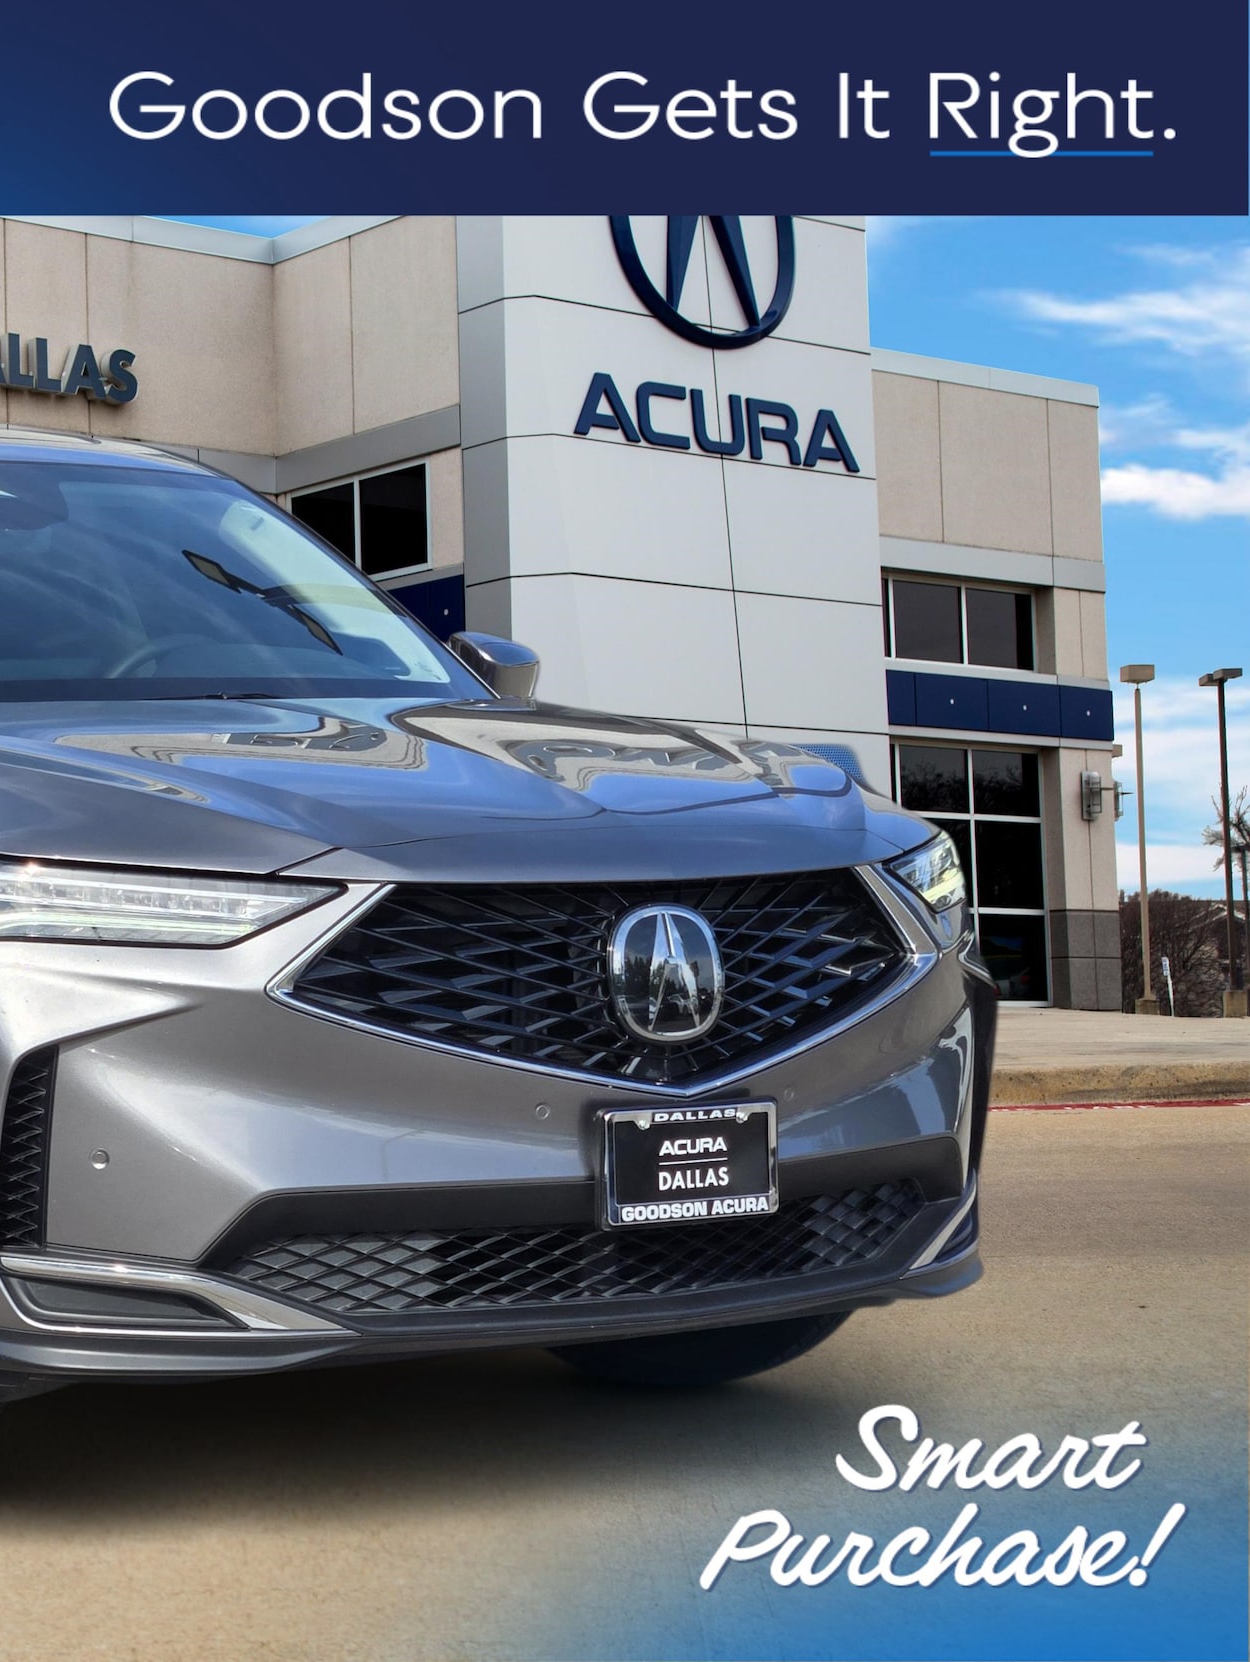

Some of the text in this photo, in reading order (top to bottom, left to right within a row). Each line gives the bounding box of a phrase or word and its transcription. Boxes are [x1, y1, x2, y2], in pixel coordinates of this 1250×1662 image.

[573, 372, 860, 473] ACURA
[654, 1108, 736, 1122] DALLAS
[658, 1136, 728, 1157] ACURA
[658, 1166, 730, 1191] DALLAS
[621, 1196, 770, 1222] GOODSON ACURA
